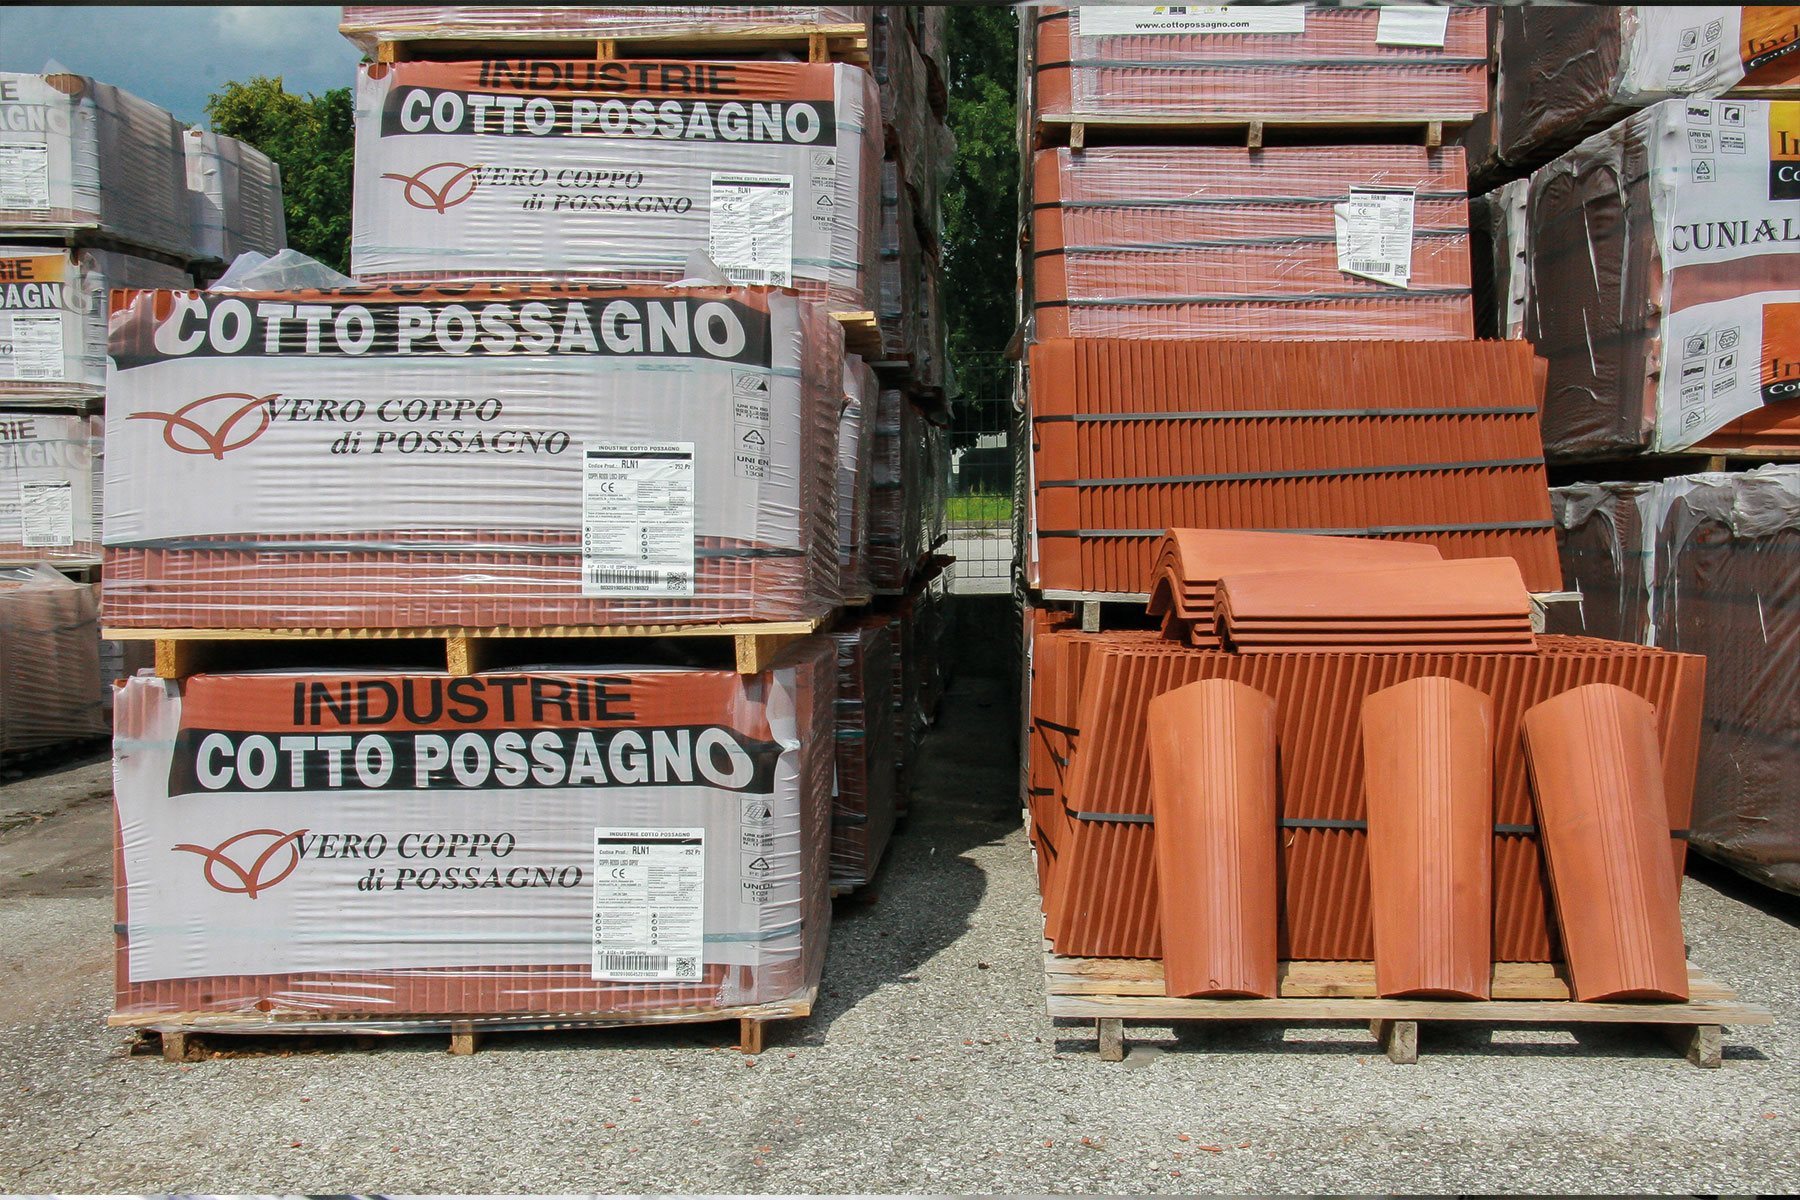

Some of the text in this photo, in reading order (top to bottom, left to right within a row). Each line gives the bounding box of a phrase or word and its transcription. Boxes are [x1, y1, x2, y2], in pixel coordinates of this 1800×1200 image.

[1135, 20, 1250, 30] www.cottopossagno.com
[478, 60, 740, 95] INDUSTRIE
[401, 88, 821, 143] COTTO POSSAGNO
[474, 167, 644, 189] VERO COPPO
[522, 193, 692, 214] di POSSAGNO
[722, 203, 733, 212] CE
[1672, 218, 1800, 252] CUNIAL
[154, 291, 746, 358] COTTO POSSAGNO
[267, 398, 504, 423] VERO COPPO
[330, 430, 572, 456] di POSSAGNO
[621, 459, 639, 469] RLN1
[736, 455, 769, 466] UNI EN
[600, 482, 615, 493] CE
[292, 677, 635, 726] INDUSTRIE
[196, 727, 754, 790] COTTO POSSAGNO
[294, 832, 516, 860] VERO COPPO
[632, 846, 650, 855] RLN1
[357, 868, 386, 892] di
[393, 866, 583, 892] POSSAGNO
[611, 868, 626, 879] CE
